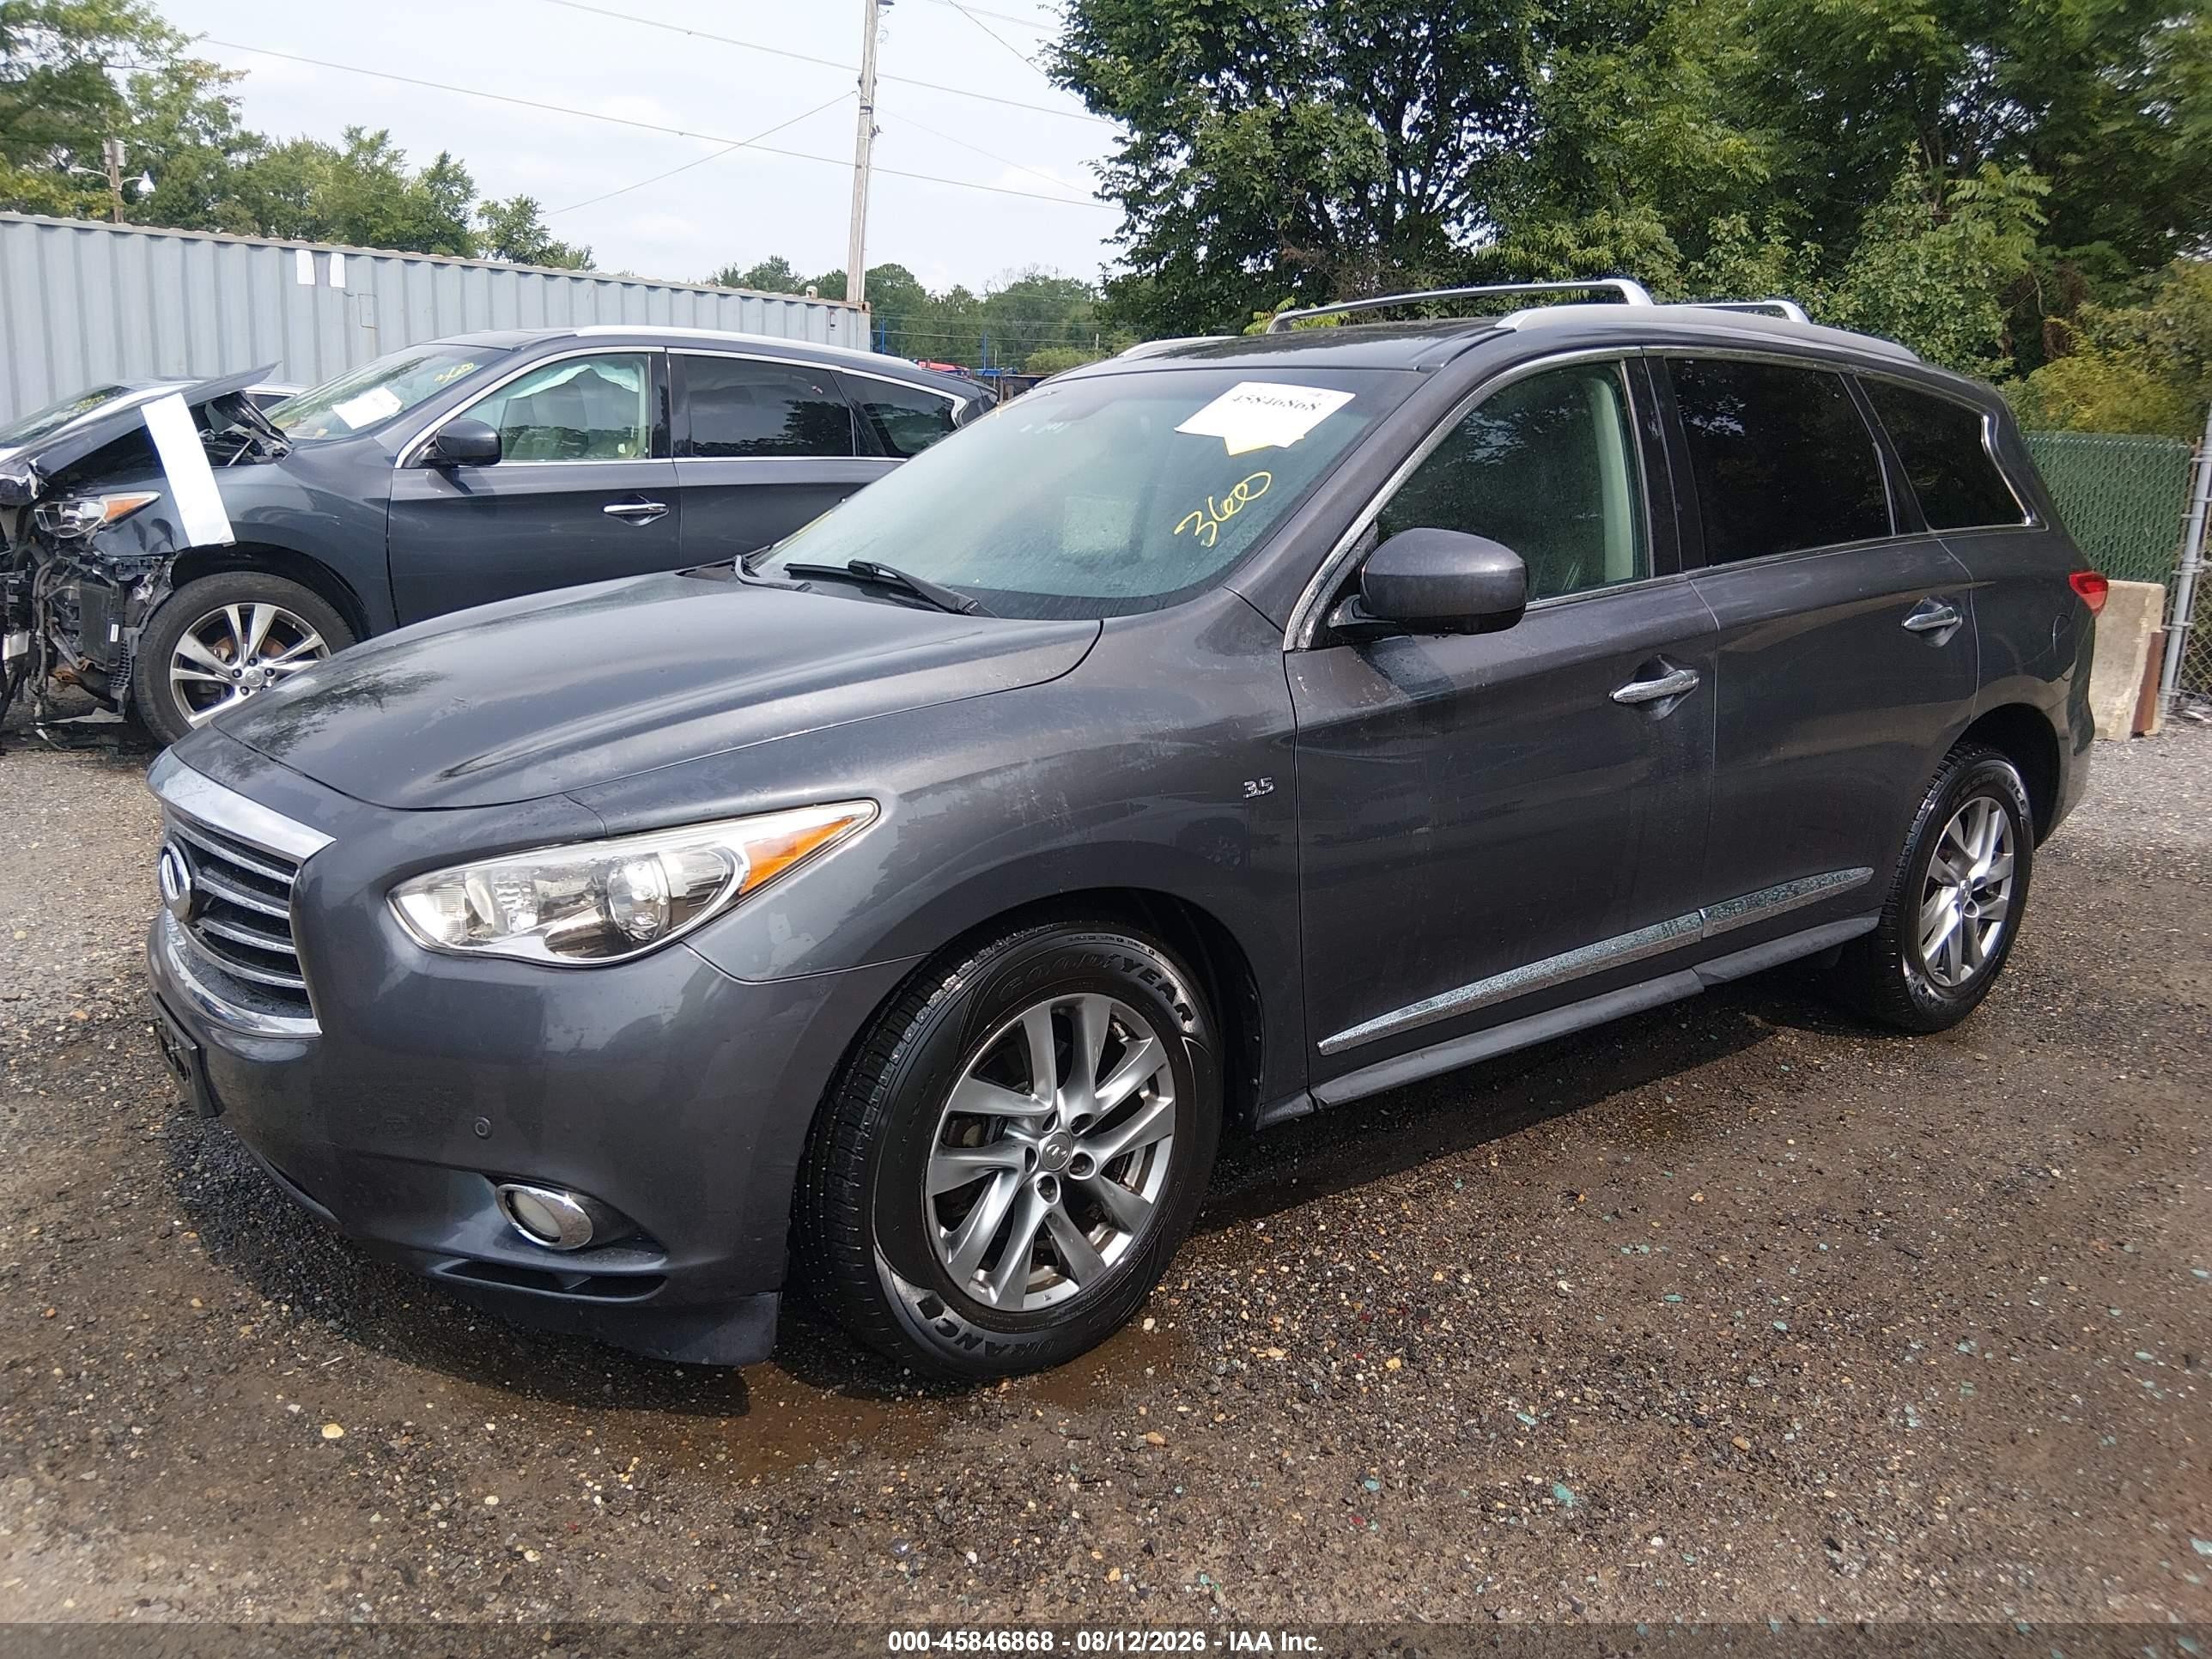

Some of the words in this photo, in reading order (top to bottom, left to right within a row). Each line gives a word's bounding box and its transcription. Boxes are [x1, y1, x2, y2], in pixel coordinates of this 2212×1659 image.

[1231, 394, 1322, 411] 45846868
[1174, 471, 1272, 547] 360
[998, 951, 1196, 1025] GOODYEAR
